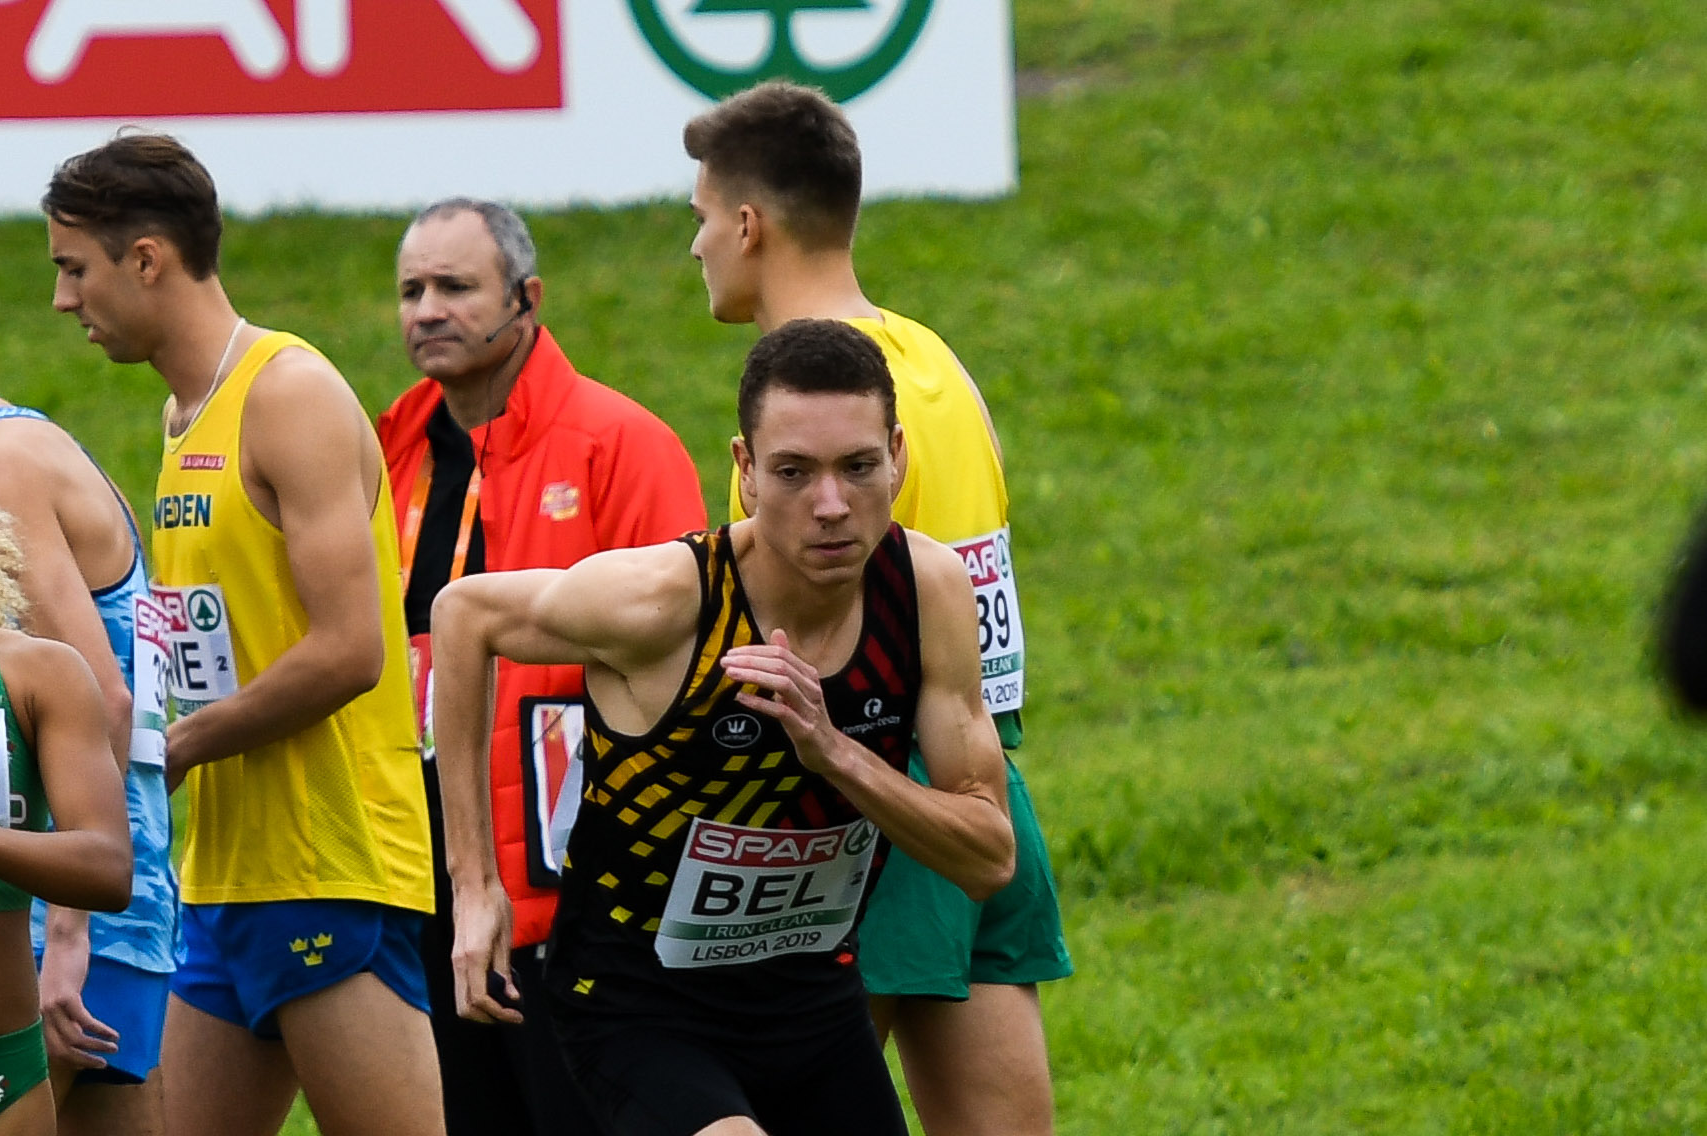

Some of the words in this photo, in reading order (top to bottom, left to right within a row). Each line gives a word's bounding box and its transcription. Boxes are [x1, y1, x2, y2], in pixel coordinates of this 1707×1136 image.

[961, 545, 998, 579] AR
[216, 656, 228, 671] 2
[695, 829, 840, 862] SPAR
[691, 871, 825, 918] BEL
[705, 926, 713, 938] I
[715, 923, 756, 938] RUN
[759, 913, 814, 931] CLEAN
[692, 939, 768, 962] LISBOA
[773, 931, 822, 951] 2019
